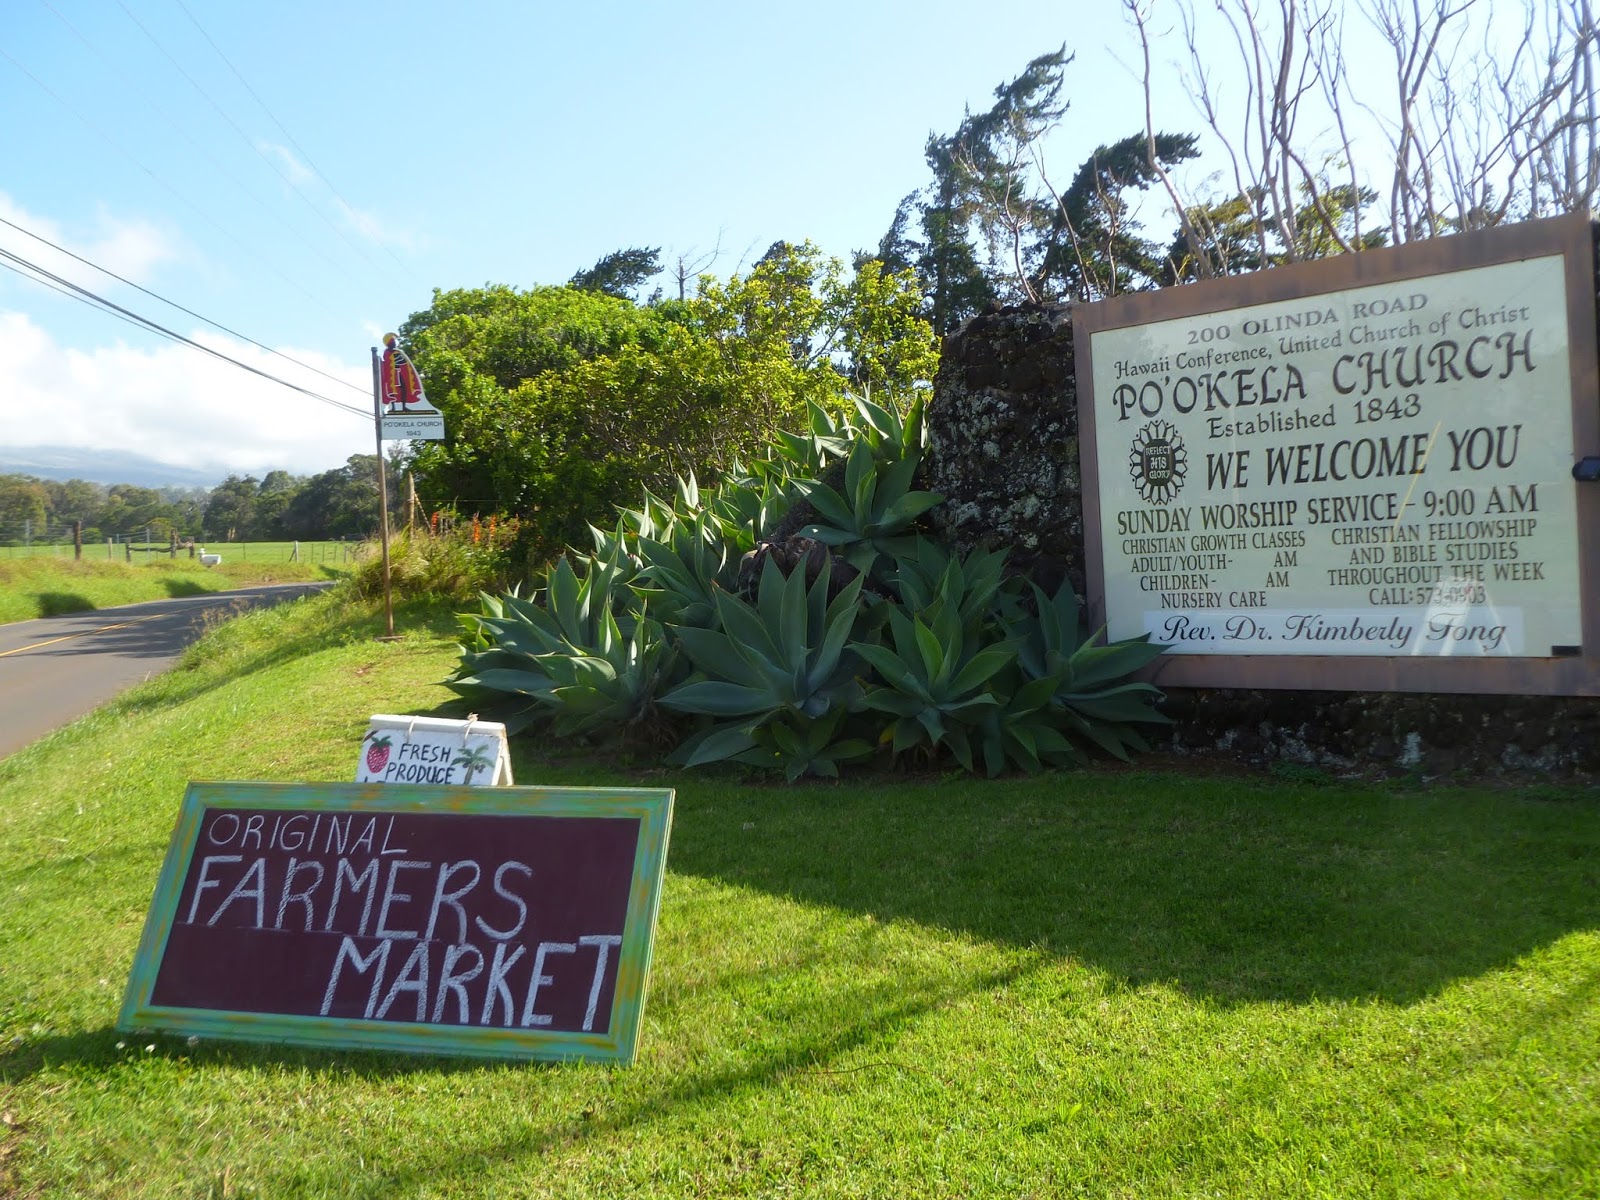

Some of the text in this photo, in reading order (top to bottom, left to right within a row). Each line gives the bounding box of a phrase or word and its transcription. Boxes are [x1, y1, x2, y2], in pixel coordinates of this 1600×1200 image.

[1187, 293, 1429, 345] 200 OLINDA ROAD
[1113, 305, 1530, 380] Hawaii Conference, United Church of Christ
[1112, 328, 1538, 421] PO'OKELA CHURCH
[1206, 393, 1422, 439] Established 1843
[1145, 445, 1171, 456] REFLECT
[1150, 456, 1167, 470] HIS
[1206, 424, 1524, 491] WE WELCOME YOU
[1149, 469, 1171, 480] GLORY
[1117, 507, 1192, 536] SUNDAY
[1200, 500, 1298, 530] WORSHIP
[1307, 493, 1399, 525] SERVICE
[1423, 488, 1476, 518] 9:00
[1484, 483, 1540, 514] AM
[1122, 530, 1306, 555] CHRISTIAN GROWTH CLASSES
[1331, 518, 1538, 546] CHRISTIAN FELLOWSHIP
[1273, 551, 1298, 568] AM
[1349, 541, 1519, 565] AND BIBLE STUDIES
[1265, 571, 1290, 588] AM
[1327, 562, 1545, 586] THROUGHOUT THE WEEK
[1160, 591, 1268, 609] NURSERY CARE
[1368, 587, 1414, 605] CALL:
[1159, 615, 1216, 641] Rev.
[1222, 615, 1273, 641] Dr.
[1281, 614, 1413, 649] Kimberly
[398, 743, 452, 763] FRESH
[385, 762, 456, 784] PRODUCE
[208, 813, 409, 855] ORIGINAL
[187, 854, 534, 944] FARMERS
[319, 934, 623, 1032] MARKET
